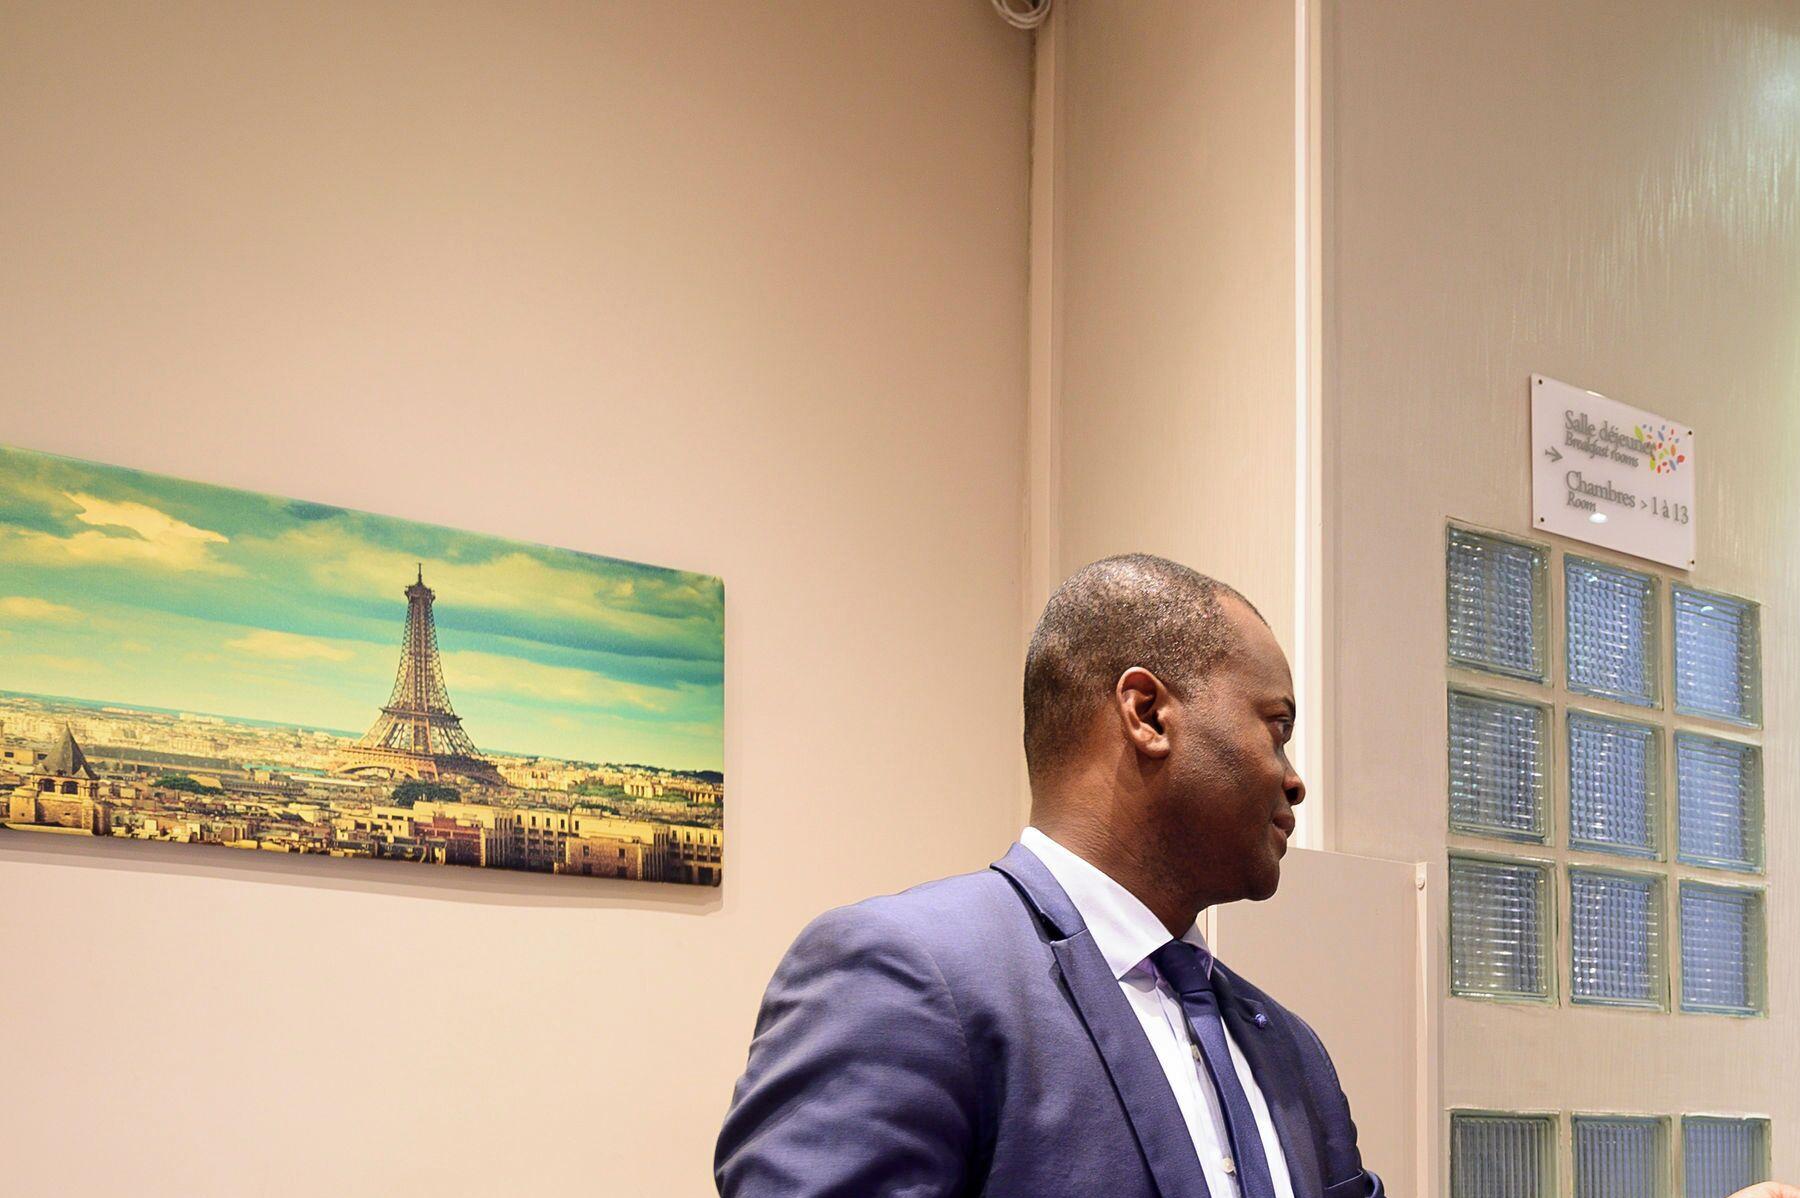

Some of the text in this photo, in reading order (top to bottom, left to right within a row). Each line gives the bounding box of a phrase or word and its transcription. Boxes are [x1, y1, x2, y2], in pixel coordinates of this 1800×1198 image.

[1564, 409, 1596, 437] Salle
[1564, 430, 1609, 459] Breakfast
[1566, 470, 1636, 508] Chambres
[1651, 496, 1659, 515] 1
[1662, 499, 1670, 519] à
[1674, 503, 1689, 525] 13
[1566, 490, 1597, 512] Room
